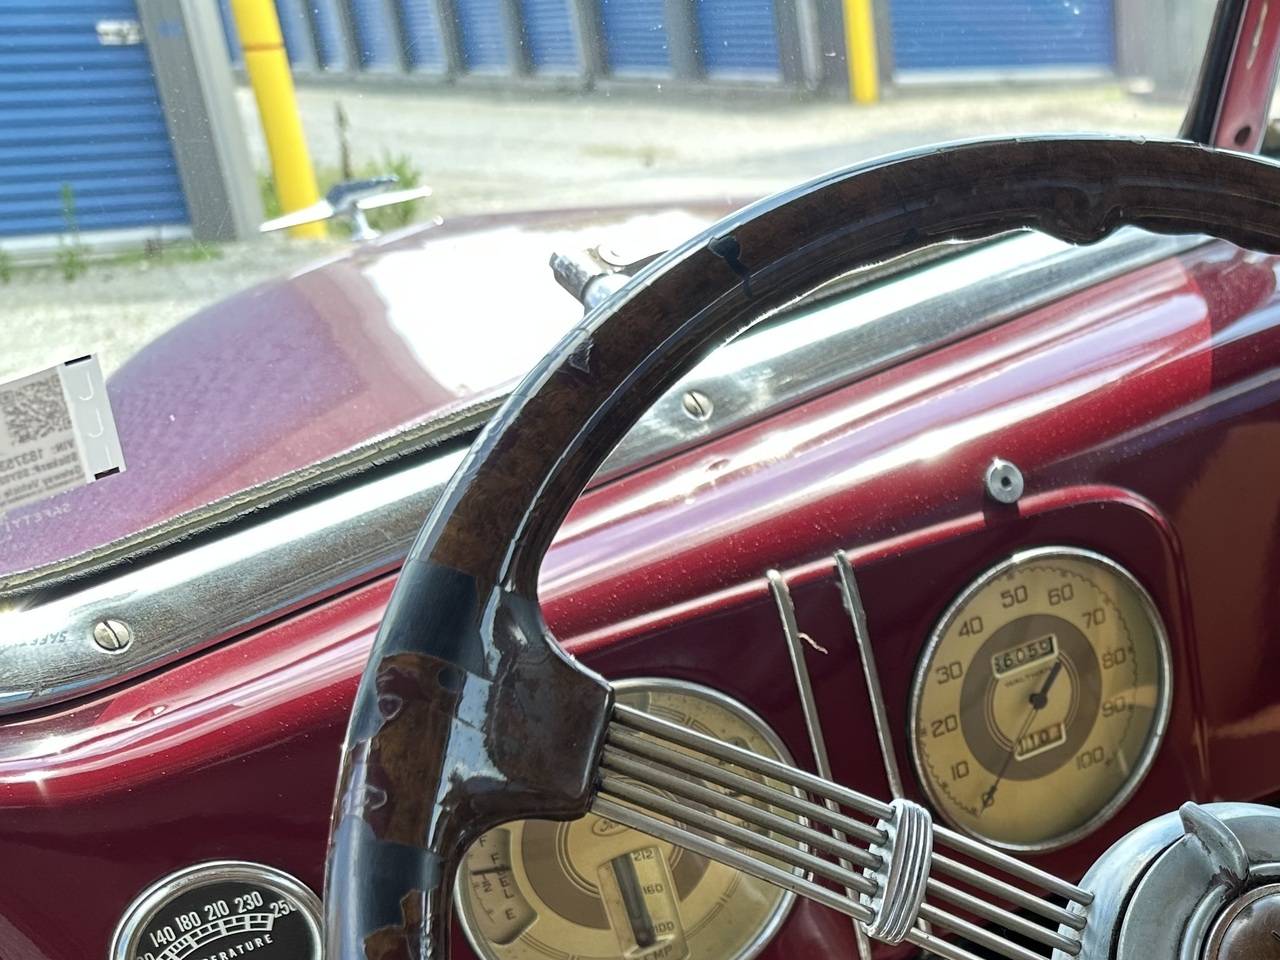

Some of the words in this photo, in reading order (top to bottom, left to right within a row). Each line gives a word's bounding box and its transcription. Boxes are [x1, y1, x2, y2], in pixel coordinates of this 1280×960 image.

[1001, 584, 1028, 608] 50
[1047, 583, 1074, 606] 60
[958, 615, 984, 638] 40
[1082, 607, 1106, 630] 70
[1102, 647, 1126, 670] 80
[936, 661, 963, 685] 30
[1102, 695, 1127, 718] 90
[931, 714, 958, 738] 20
[1076, 746, 1105, 770] 100
[951, 760, 969, 780] 10
[150, 925, 176, 948] 140
[175, 911, 202, 933] 180
[204, 900, 230, 921] 210
[235, 891, 264, 914] 230
